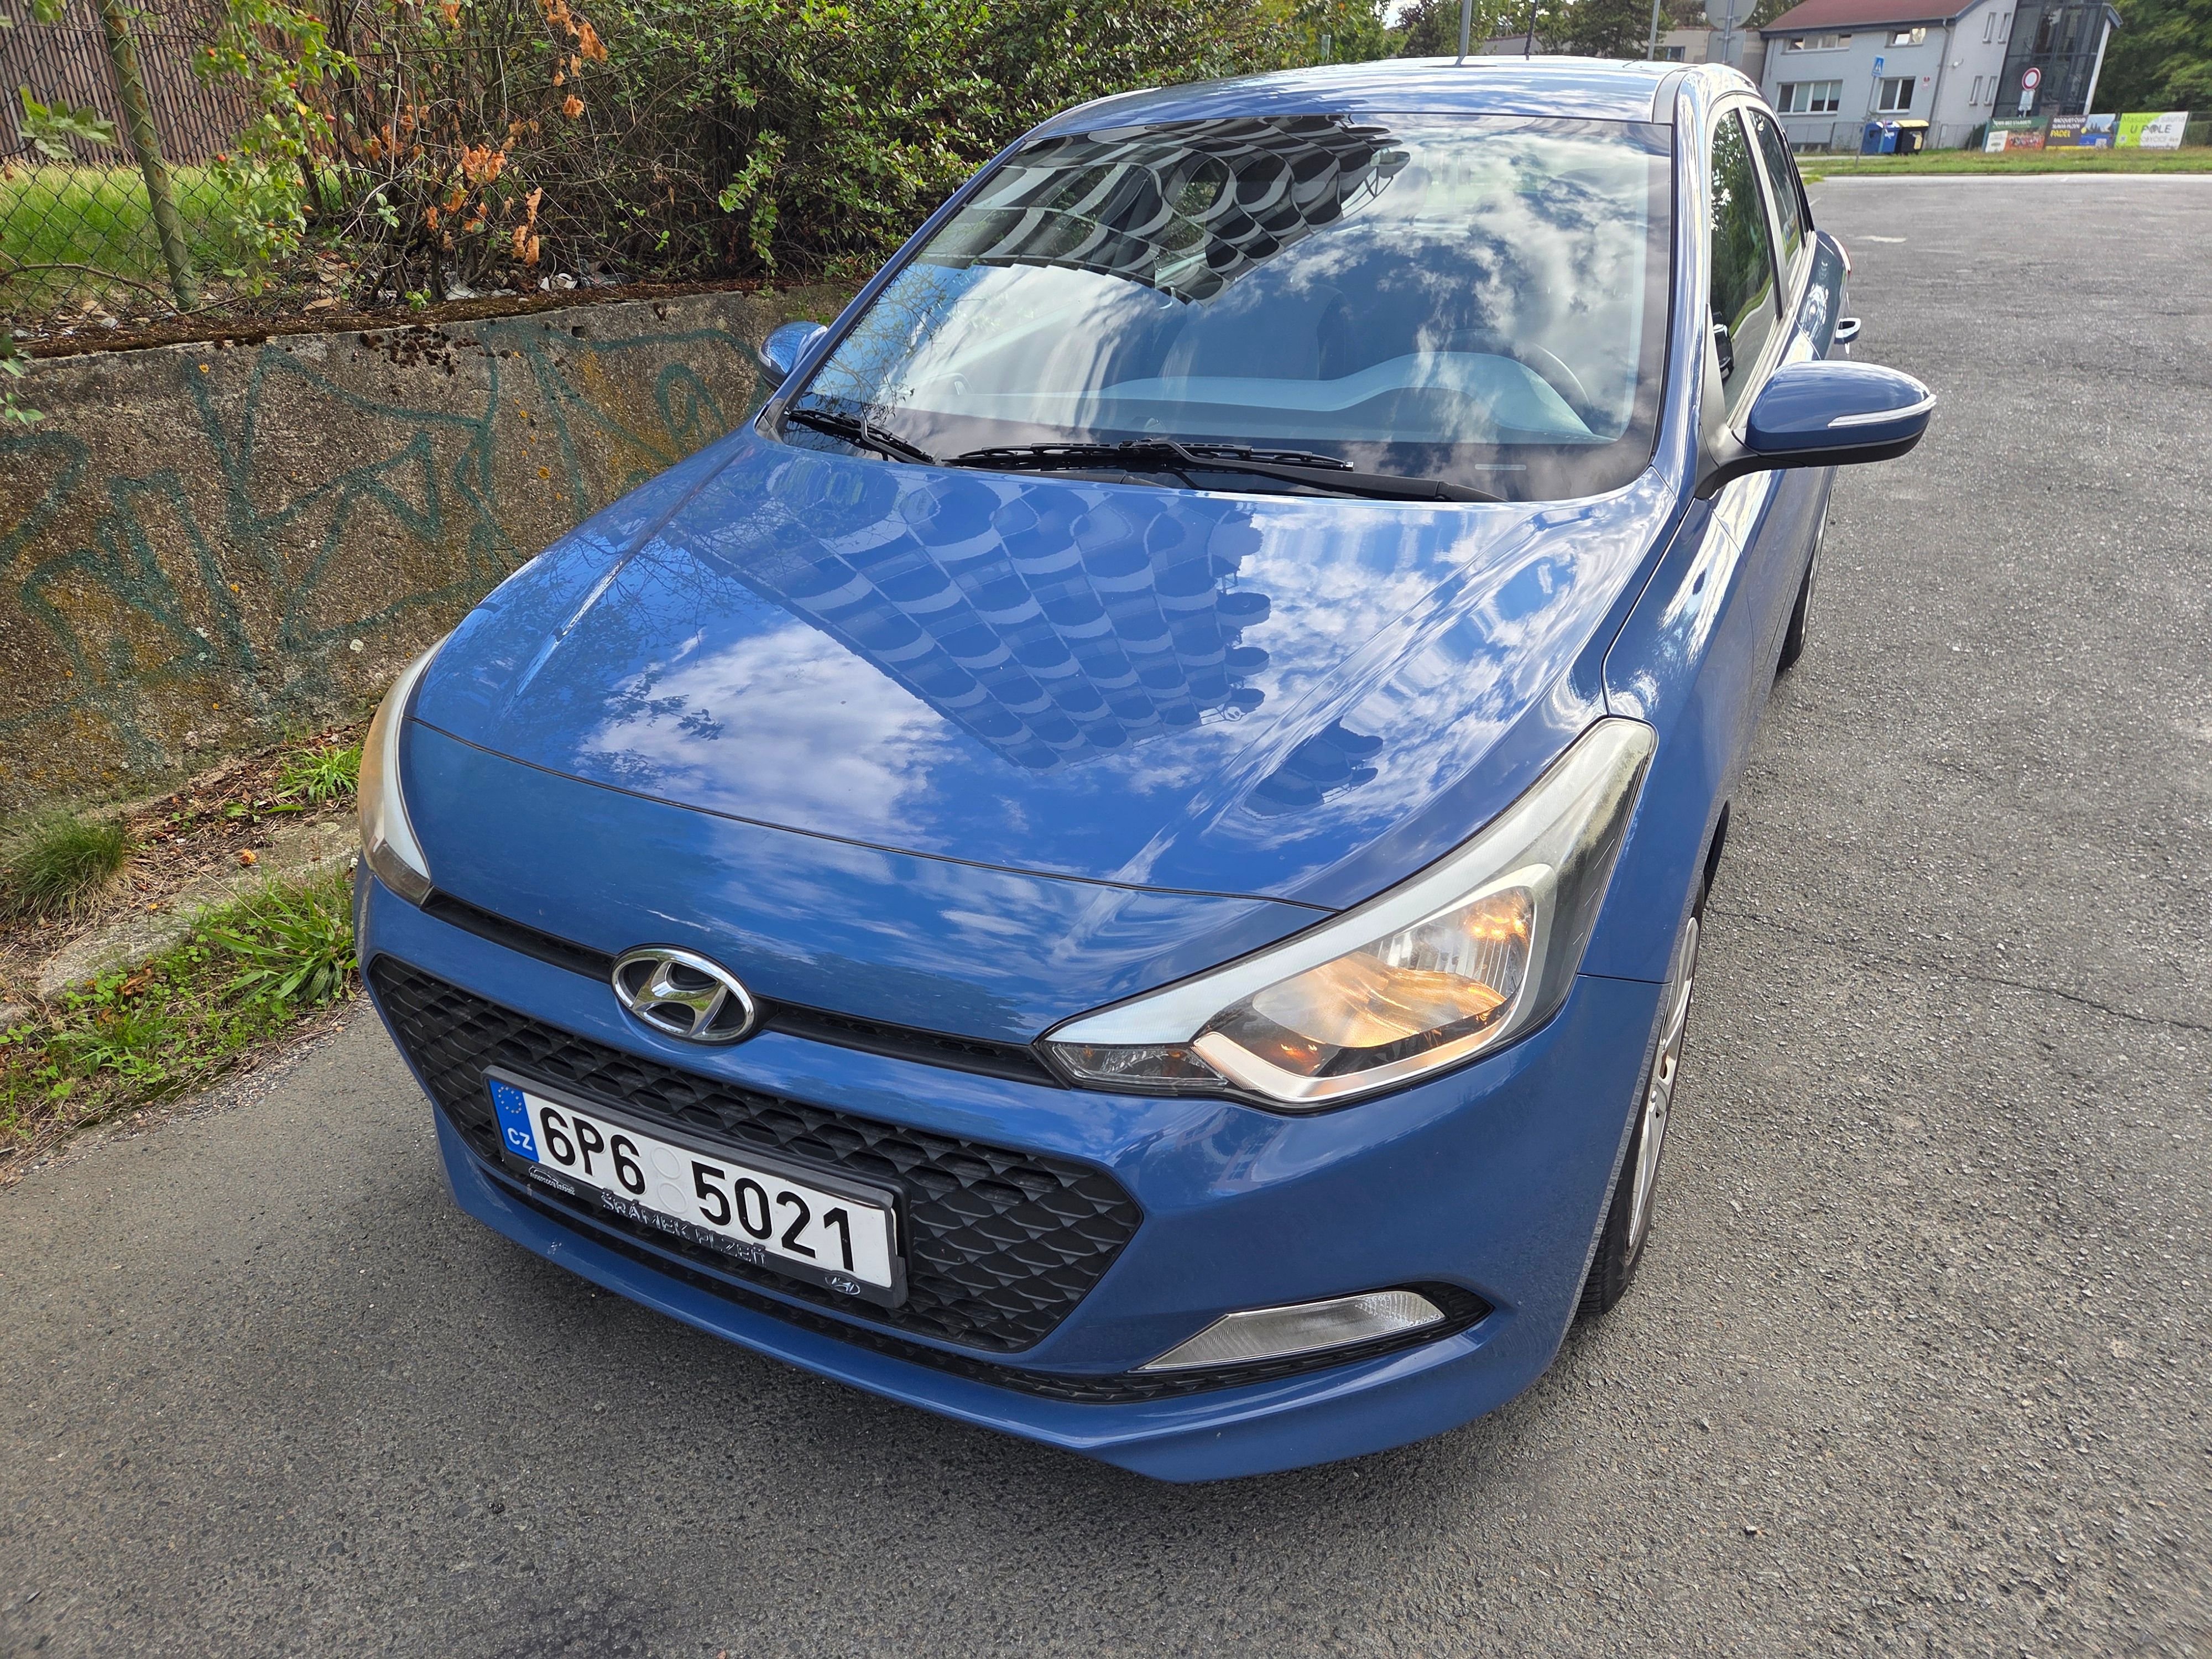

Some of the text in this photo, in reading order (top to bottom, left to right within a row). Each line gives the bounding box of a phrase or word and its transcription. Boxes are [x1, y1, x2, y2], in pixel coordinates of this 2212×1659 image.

[507, 1127, 533, 1151] CZ
[539, 1107, 854, 1272] 6P6 5021
